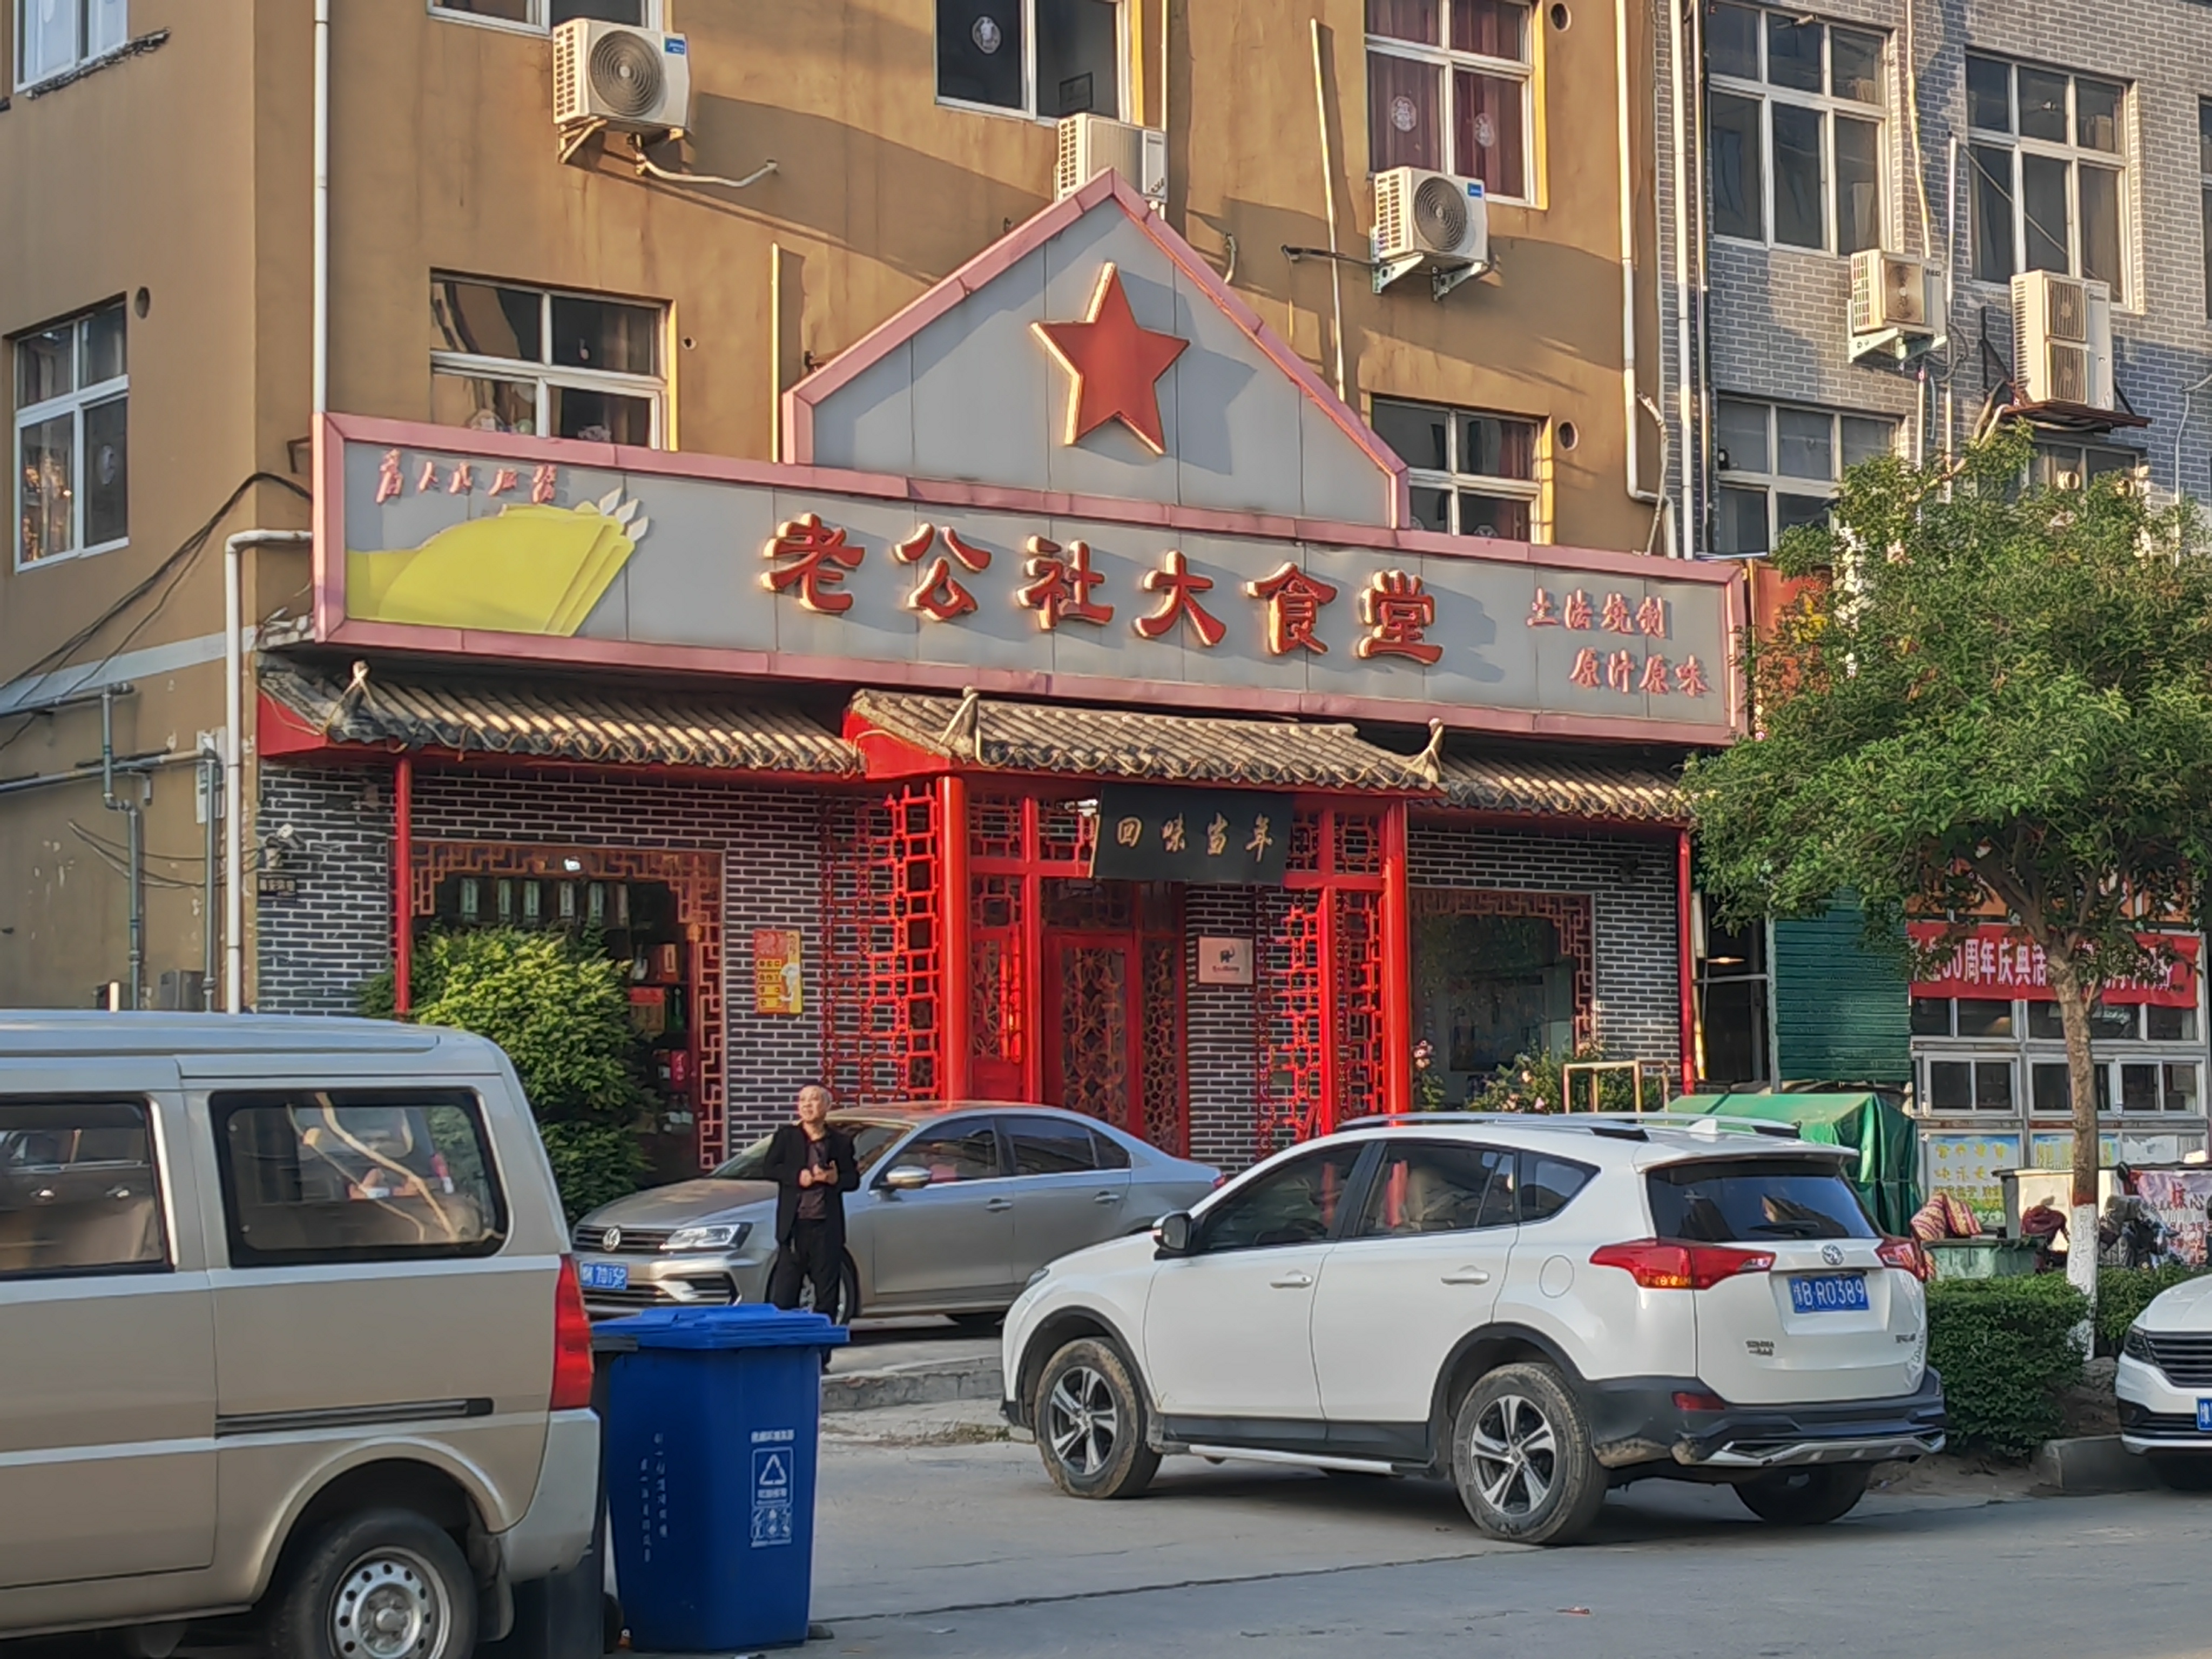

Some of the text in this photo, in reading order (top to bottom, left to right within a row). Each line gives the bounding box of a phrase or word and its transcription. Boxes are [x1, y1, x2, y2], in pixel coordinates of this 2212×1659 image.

[760, 511, 1442, 665] 老公社大食堂
[1570, 648, 1708, 697] 原汁原味
